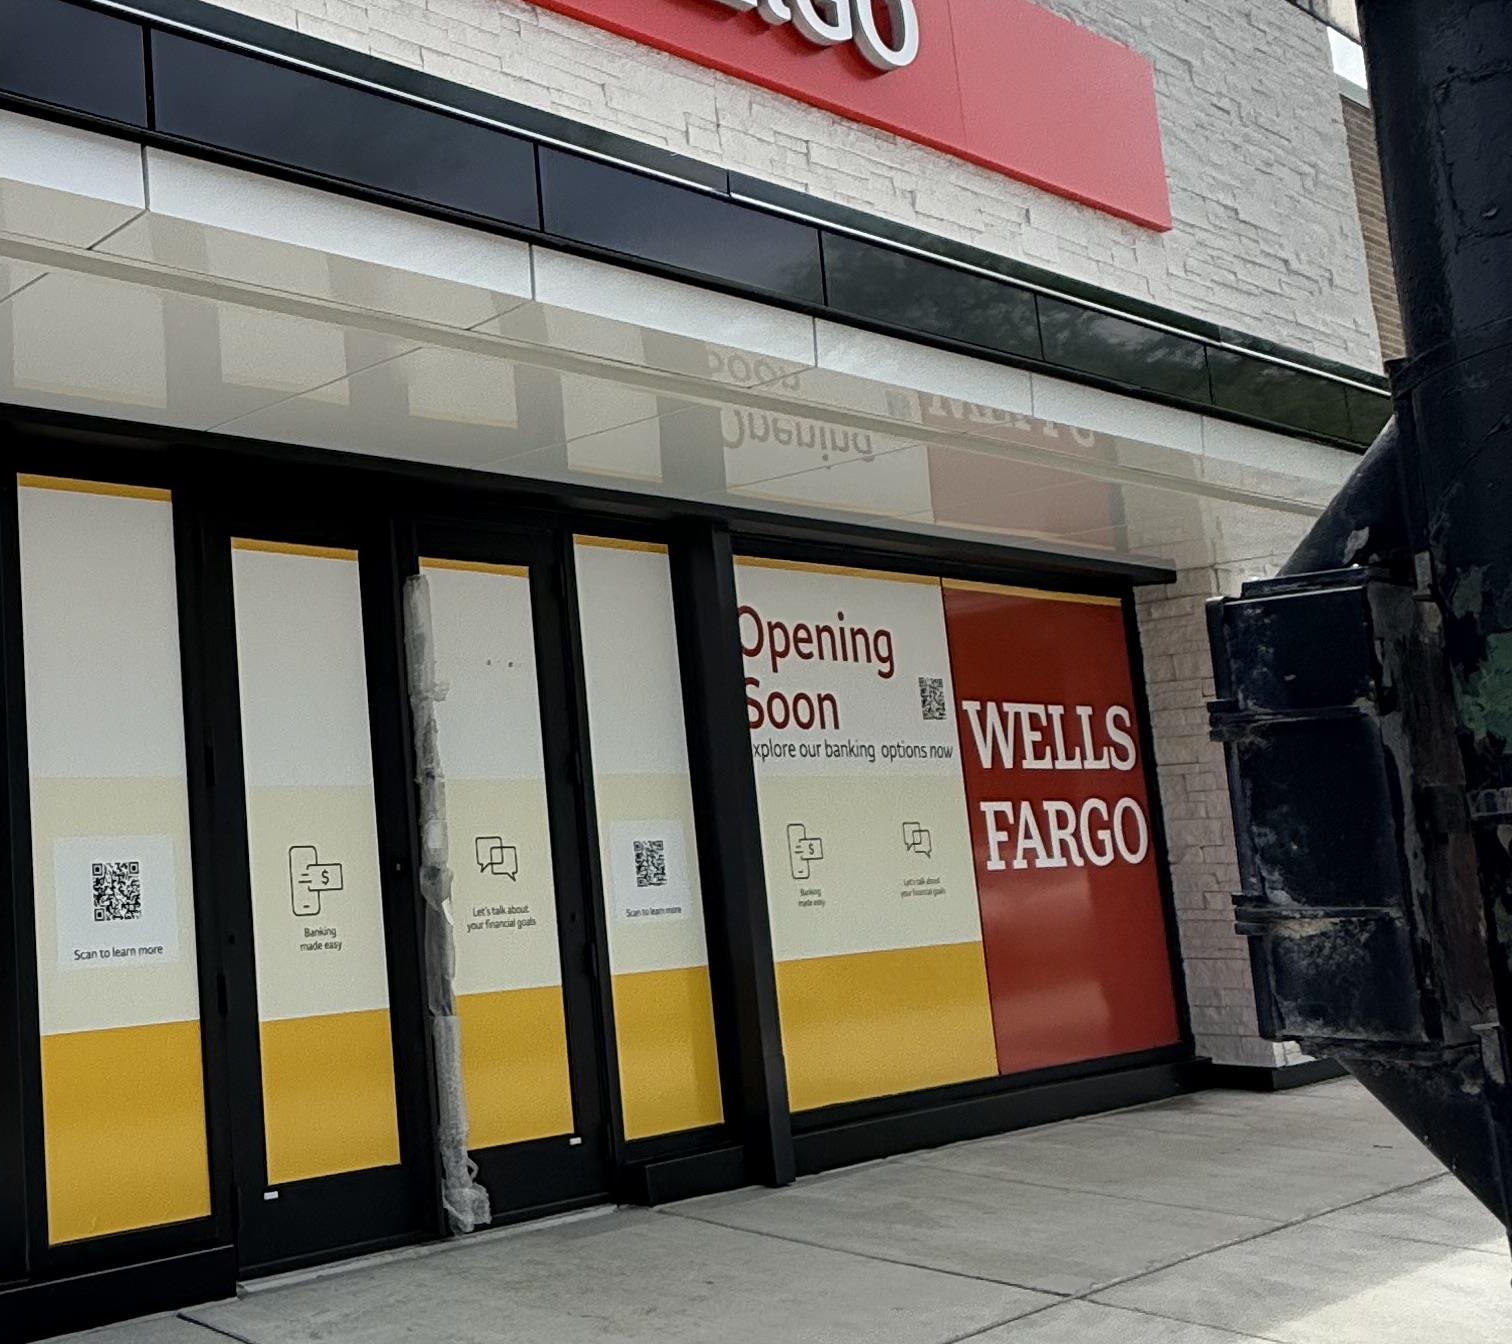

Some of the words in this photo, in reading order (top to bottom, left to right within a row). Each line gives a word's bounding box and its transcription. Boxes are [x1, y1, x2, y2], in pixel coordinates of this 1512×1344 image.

[738, 605, 895, 679] Opening
[744, 676, 840, 730] Soon
[962, 700, 1136, 771] WELLS
[753, 738, 796, 763] xplore
[799, 742, 822, 758] our
[825, 739, 875, 763] banking
[881, 740, 928, 762] options
[930, 744, 954, 759] now
[980, 797, 1148, 870] FARGO
[473, 906, 491, 917] Let's
[492, 905, 506, 915] talk
[508, 904, 530, 915] about
[304, 926, 336, 938] Banking
[467, 922, 484, 933] your
[485, 918, 516, 929] financial
[517, 916, 536, 930] goals
[74, 949, 97, 960] Scan
[99, 948, 110, 959] to
[112, 946, 136, 957] learn
[138, 944, 163, 956] more
[300, 940, 322, 951] made
[324, 941, 342, 952] easy
